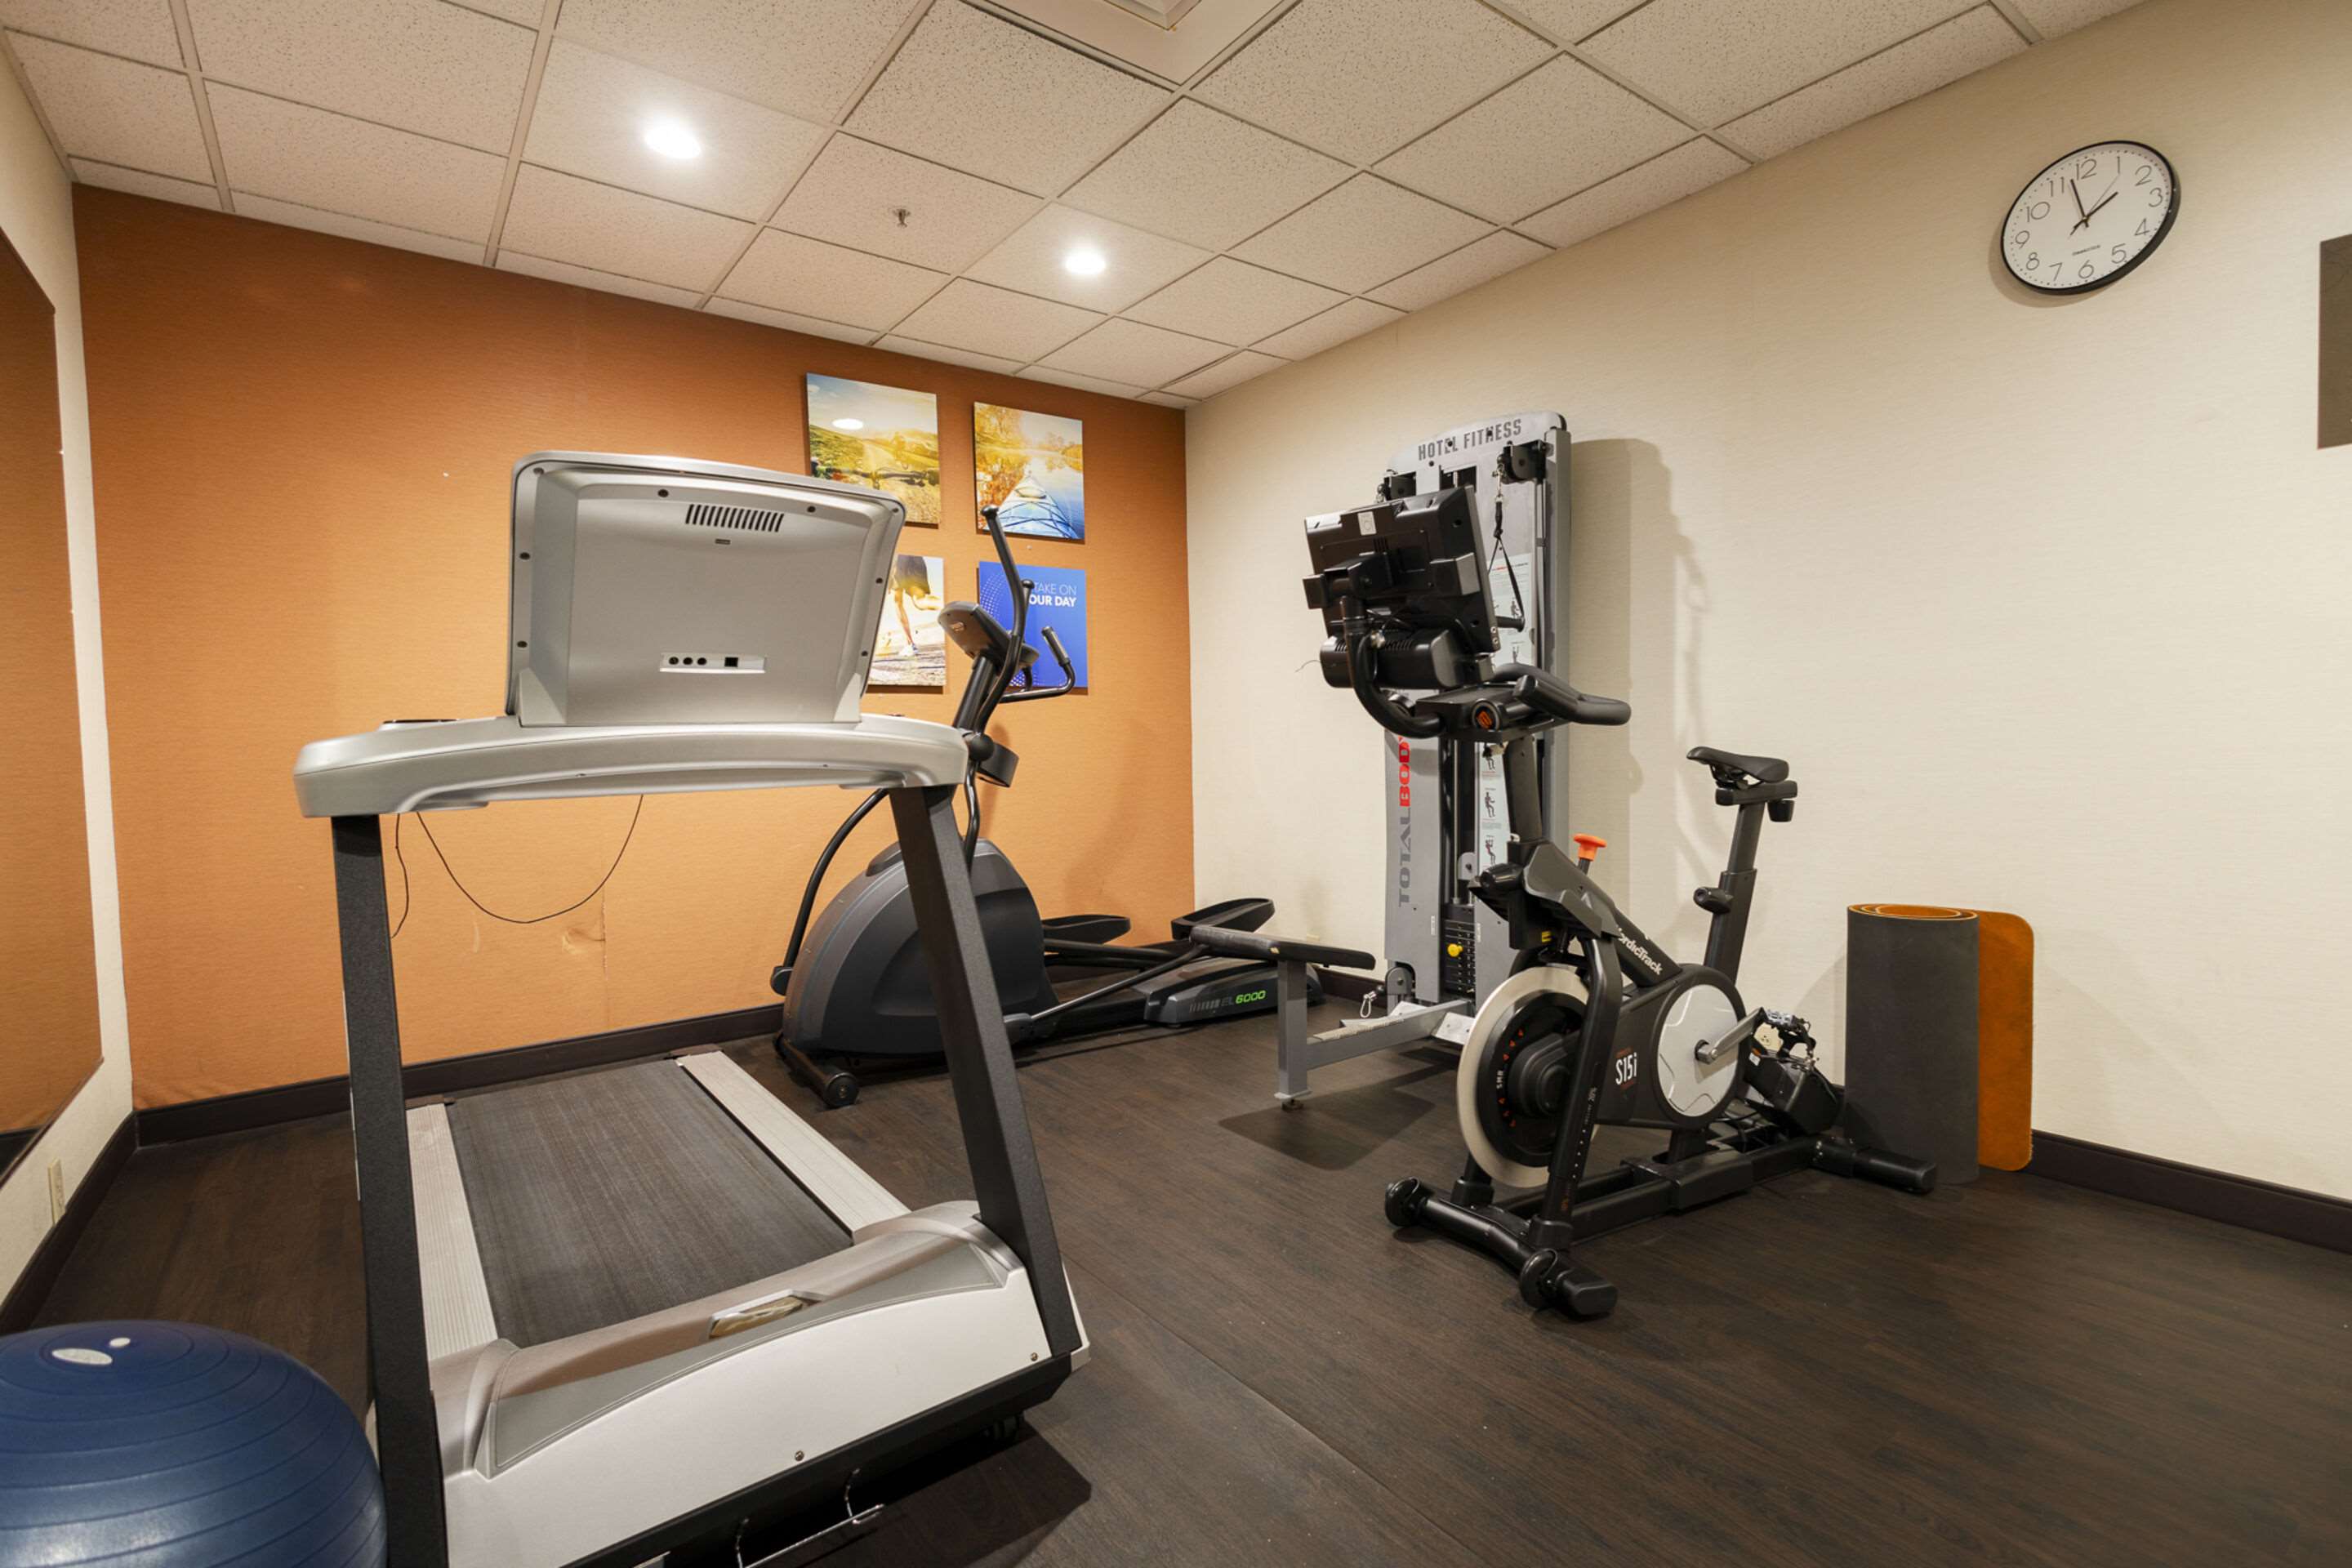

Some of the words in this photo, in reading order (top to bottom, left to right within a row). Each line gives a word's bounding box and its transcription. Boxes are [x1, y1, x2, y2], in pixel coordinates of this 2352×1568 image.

[2075, 158, 2097, 180] 12
[2116, 155, 2121, 175] 1
[2134, 165, 2152, 186] 2
[2049, 176, 2065, 197] 11
[2148, 187, 2163, 207] 3
[2026, 201, 2051, 222] 10
[2134, 218, 2150, 237] 4
[2015, 230, 2030, 249] 9
[2025, 252, 2040, 271] 8
[2110, 243, 2127, 264] 5
[2049, 262, 2063, 282] 7
[2078, 260, 2095, 279] 6
[1418, 436, 1459, 461] HOTEL
[1463, 419, 1521, 449] FITNESS
[1034, 582, 1057, 595] TAKE
[1058, 584, 1077, 595] ON
[1029, 595, 1052, 606] OUR
[1054, 595, 1077, 608] DAY
[1618, 927, 1663, 975] ordicTrack
[1235, 990, 1267, 1004] 6000
[1615, 1052, 1637, 1085] S15i
